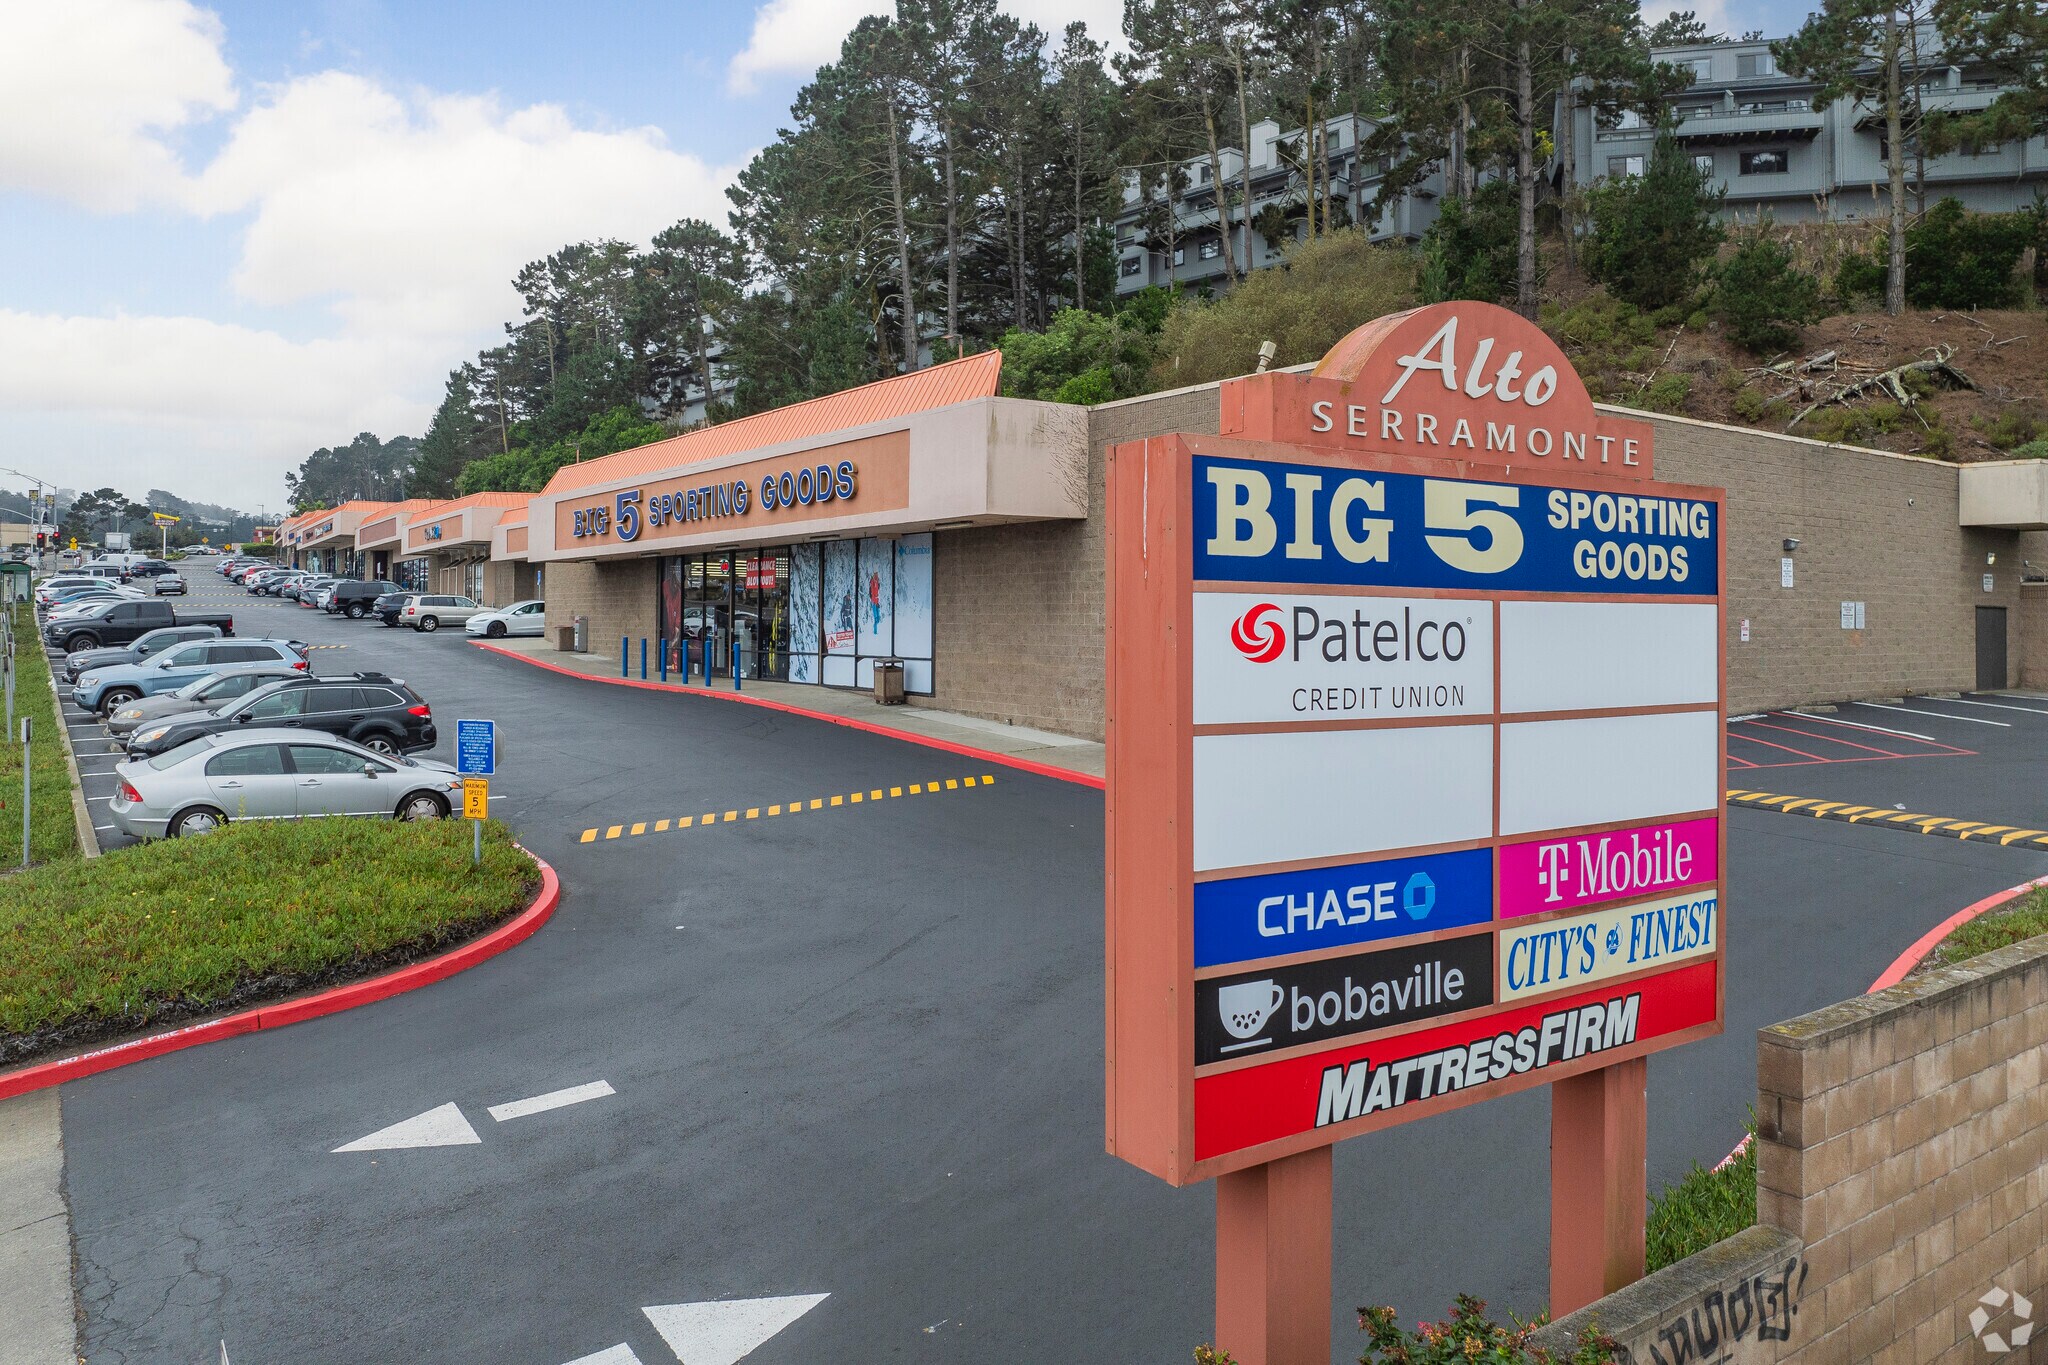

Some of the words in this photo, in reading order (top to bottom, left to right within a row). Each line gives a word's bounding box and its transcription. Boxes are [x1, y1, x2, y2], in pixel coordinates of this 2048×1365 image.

[1381, 316, 1557, 406] Alto
[1310, 400, 1640, 467] SERRAMONTE
[572, 505, 611, 538] BIG
[614, 488, 643, 542] 5
[648, 479, 751, 527] SPORTING
[759, 459, 859, 512] GOODS
[1206, 465, 1395, 565] BIG
[1423, 478, 1525, 575] 5
[1547, 489, 1711, 539] SPORTING
[1572, 539, 1690, 583] GOODS
[1293, 605, 1466, 664] Patelco
[1292, 686, 1383, 712] CREDIT
[1391, 684, 1465, 708] UNION
[472, 797, 479, 807] 5
[1576, 829, 1693, 898] Mobile
[1257, 881, 1397, 937] CHASE
[1507, 923, 1598, 991] CITY'S
[1627, 898, 1717, 964] FINEST
[1291, 961, 1465, 1032] bobaville
[57, 1056, 78, 1065] NO
[83, 1039, 142, 1059] PARKING
[148, 1030, 179, 1042] FIRE
